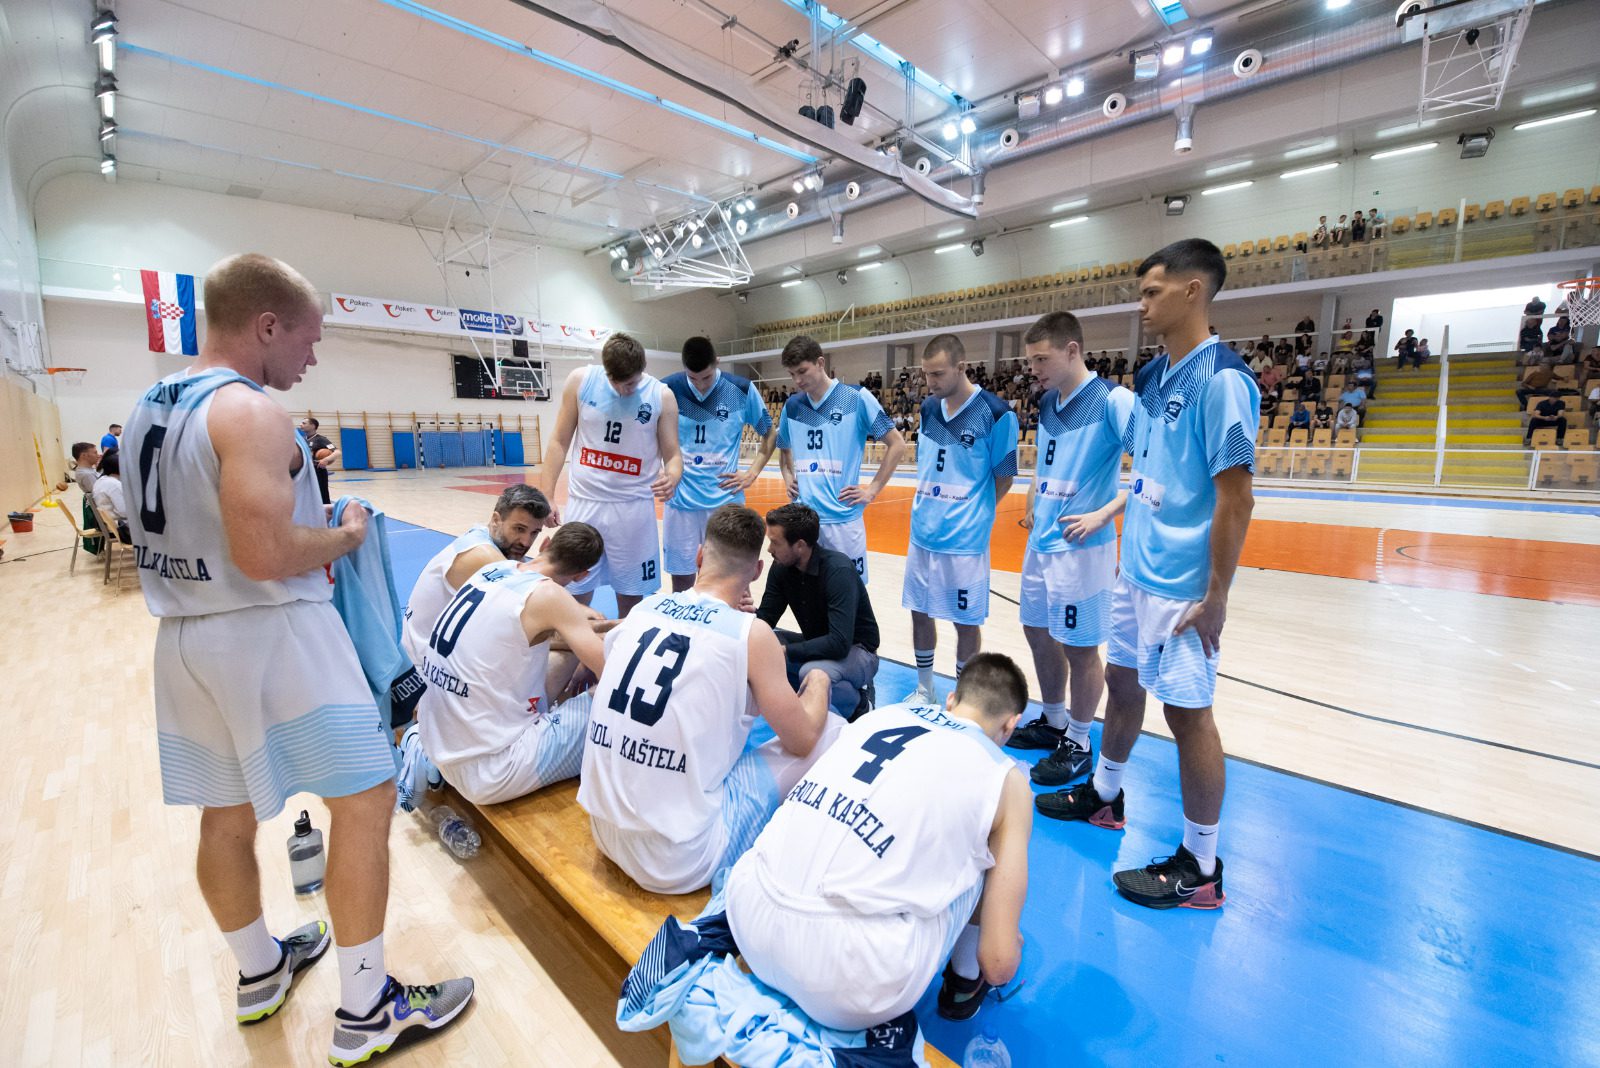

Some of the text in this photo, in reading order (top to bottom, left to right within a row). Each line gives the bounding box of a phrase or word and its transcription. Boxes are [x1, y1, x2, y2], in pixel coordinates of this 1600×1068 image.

[463, 313, 499, 326] molten
[603, 420, 623, 445] 12
[694, 424, 706, 444] 11
[807, 429, 823, 450] 33
[587, 452, 639, 474] Ribola
[936, 448, 947, 473] 5
[1045, 439, 1057, 466] 8
[641, 559, 656, 582] 12
[958, 589, 968, 610] 5
[429, 583, 486, 659] 10
[1064, 604, 1078, 630] 8
[608, 626, 691, 727] 13
[589, 720, 687, 774] OL KAŠTELA
[852, 725, 932, 785] 4
